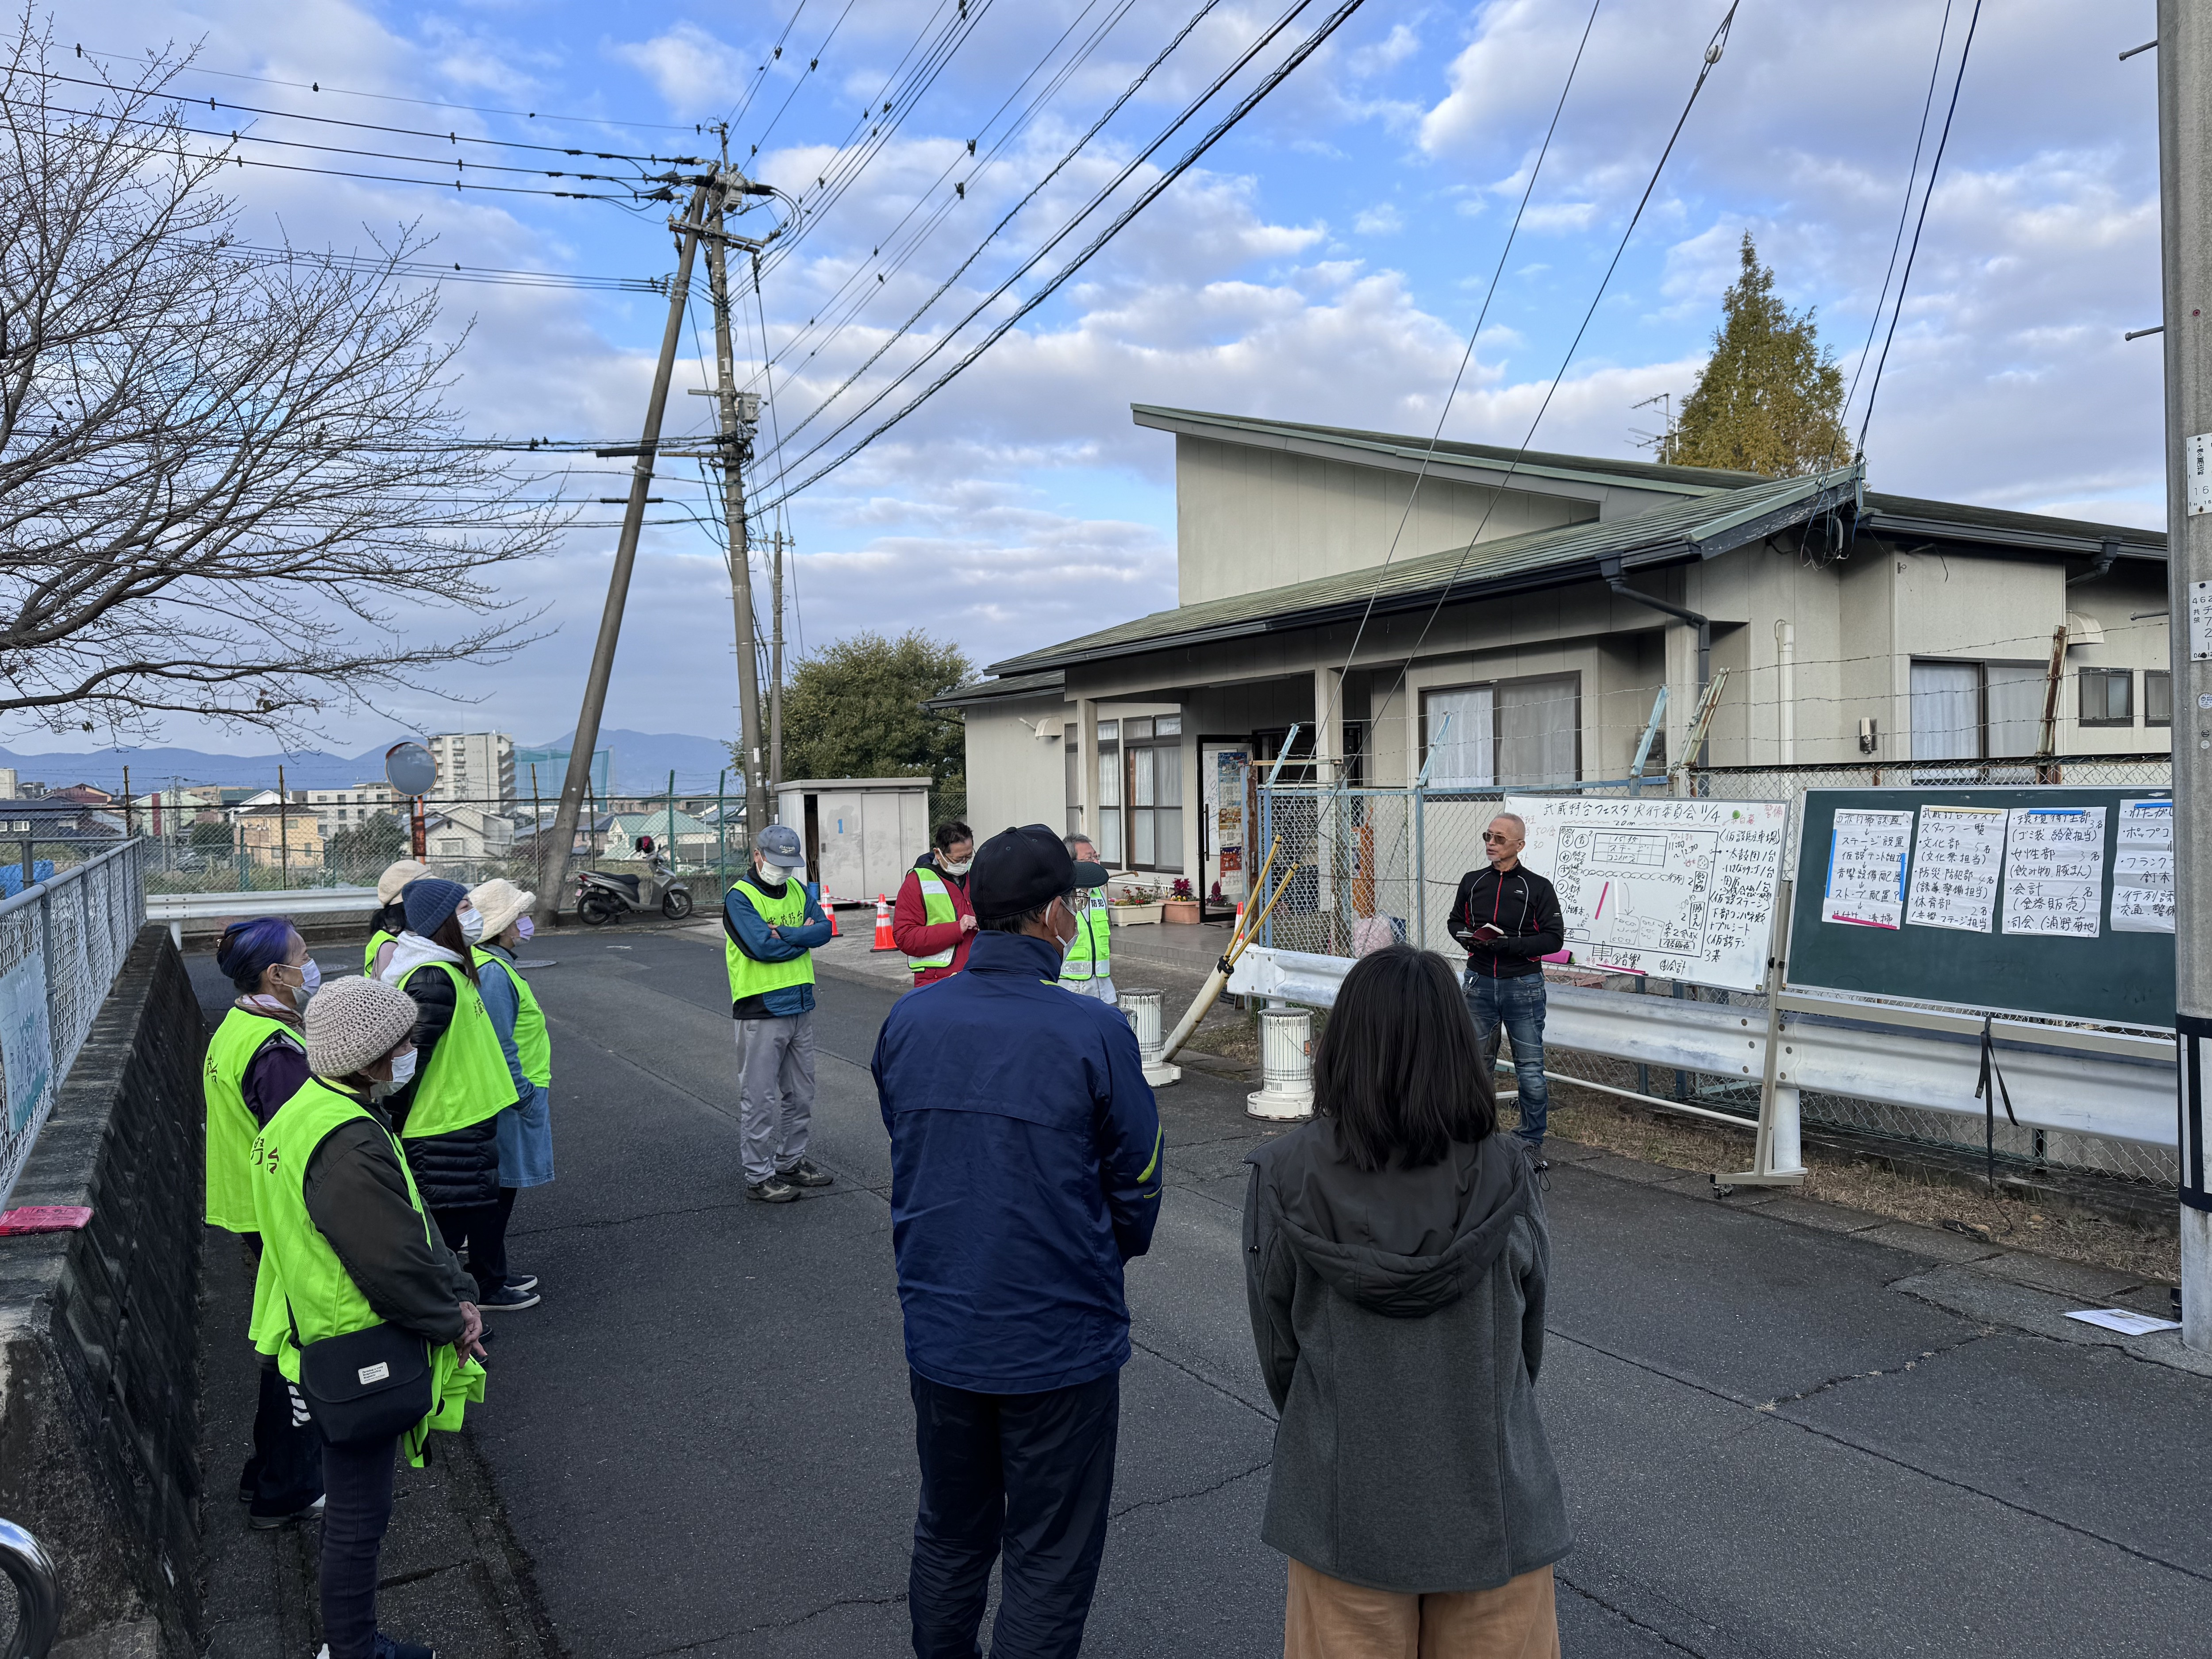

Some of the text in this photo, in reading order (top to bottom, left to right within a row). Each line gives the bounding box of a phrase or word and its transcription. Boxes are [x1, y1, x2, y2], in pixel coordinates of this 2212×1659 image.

[838, 818, 843, 834] 1
[1842, 835, 1904, 847] ステージ設置
[1091, 899, 1104, 908] 防犯
